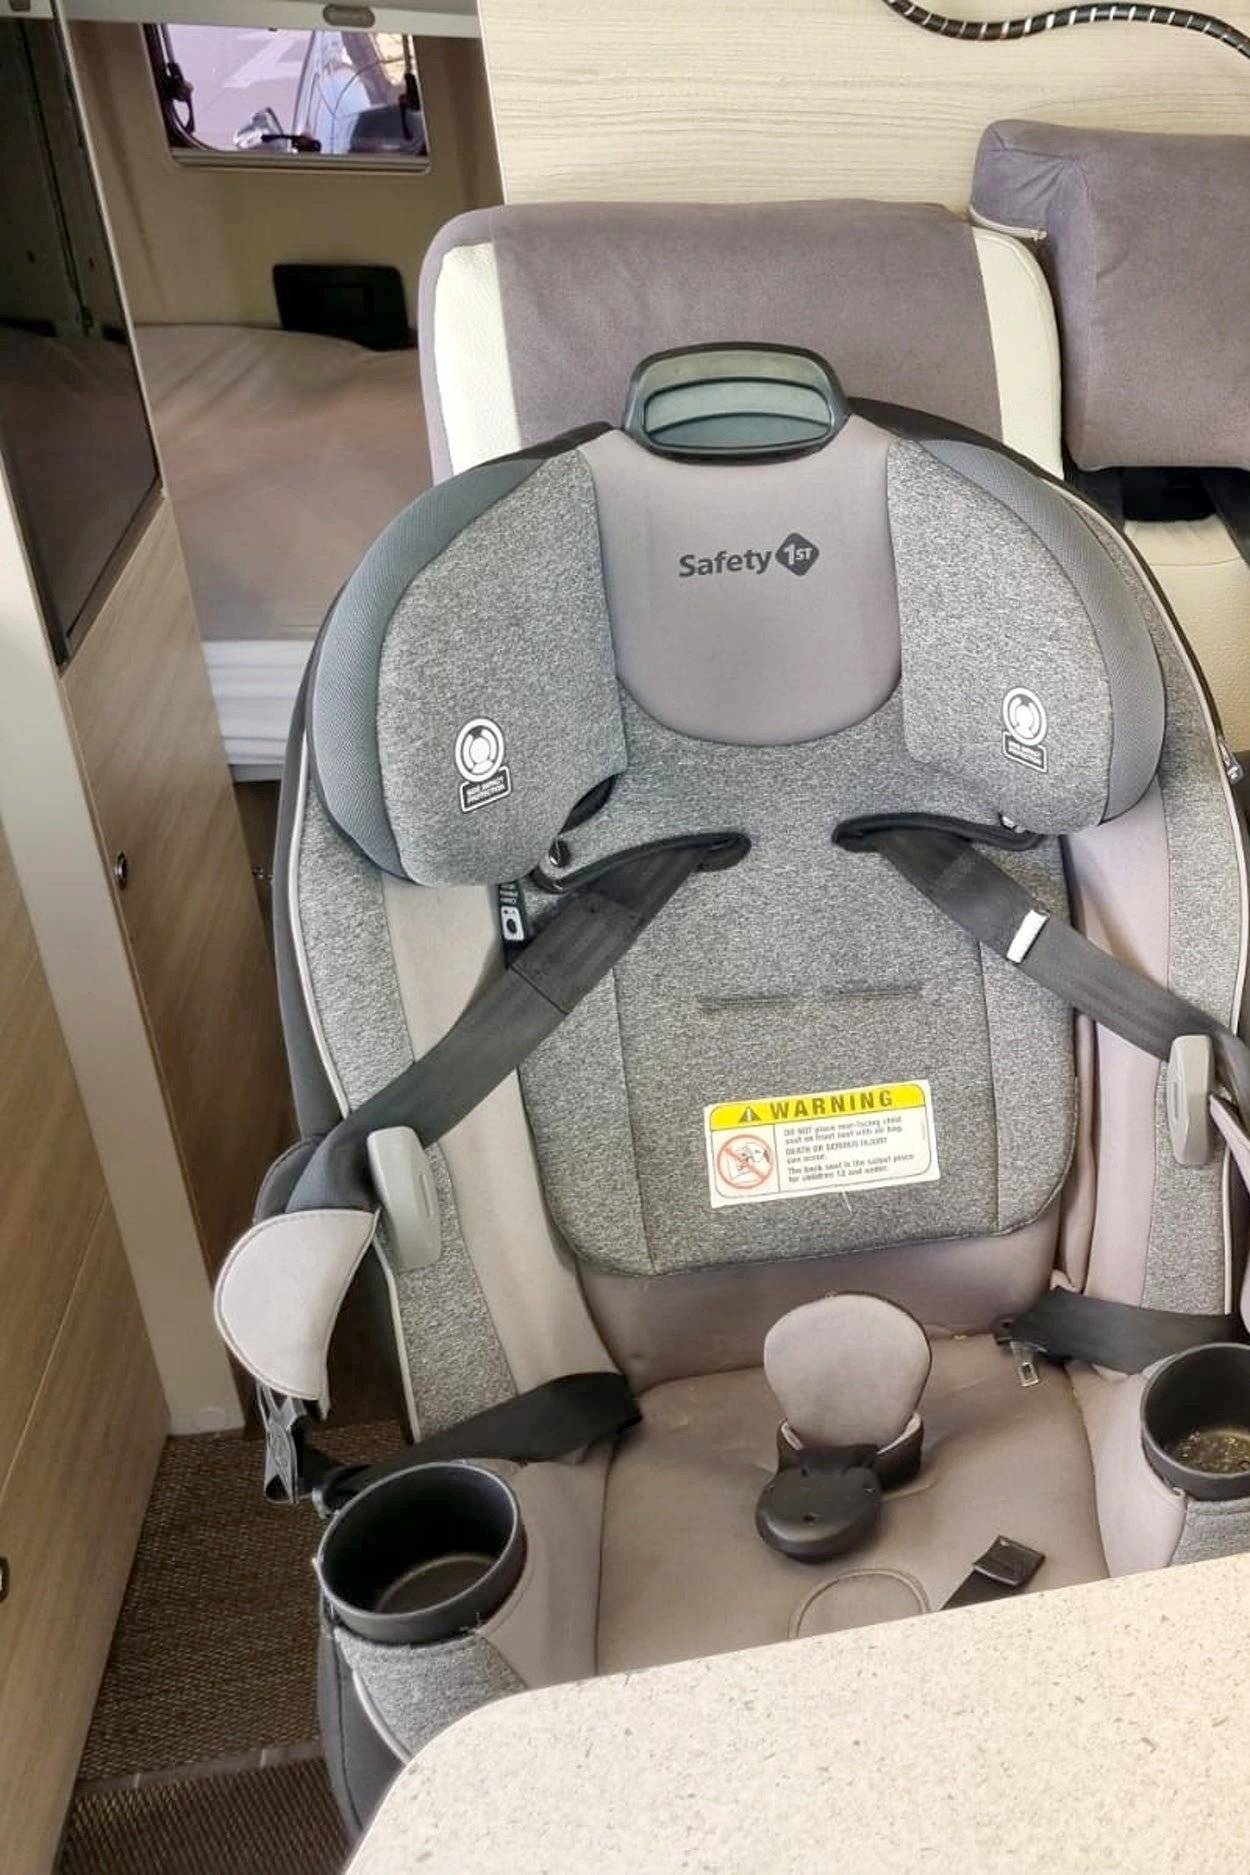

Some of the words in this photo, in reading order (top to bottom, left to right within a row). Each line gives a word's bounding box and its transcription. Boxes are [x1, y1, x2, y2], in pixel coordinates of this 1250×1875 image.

[679, 549, 773, 578] Safety
[770, 1090, 893, 1119] WARNING
[797, 1126, 811, 1134] NOT
